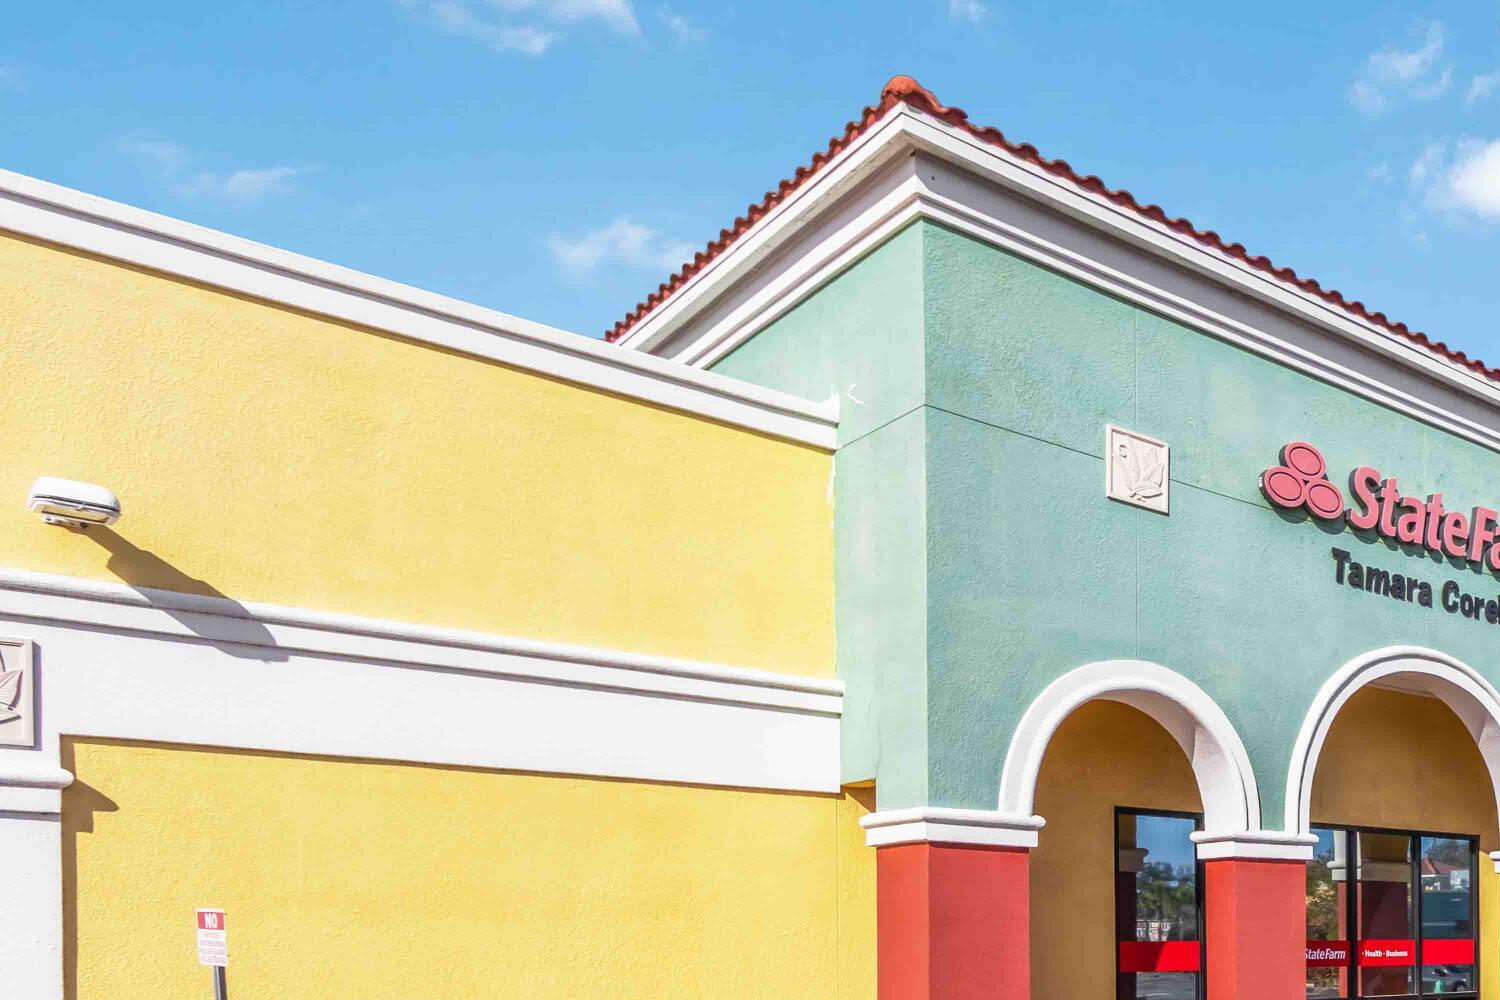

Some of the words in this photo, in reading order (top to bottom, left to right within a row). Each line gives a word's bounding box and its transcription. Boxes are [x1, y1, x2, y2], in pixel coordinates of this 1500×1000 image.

[1331, 547, 1433, 609] Tamara
[203, 912, 218, 929] NO
[1364, 949, 1383, 957] Health
[1385, 949, 1409, 958] Business
